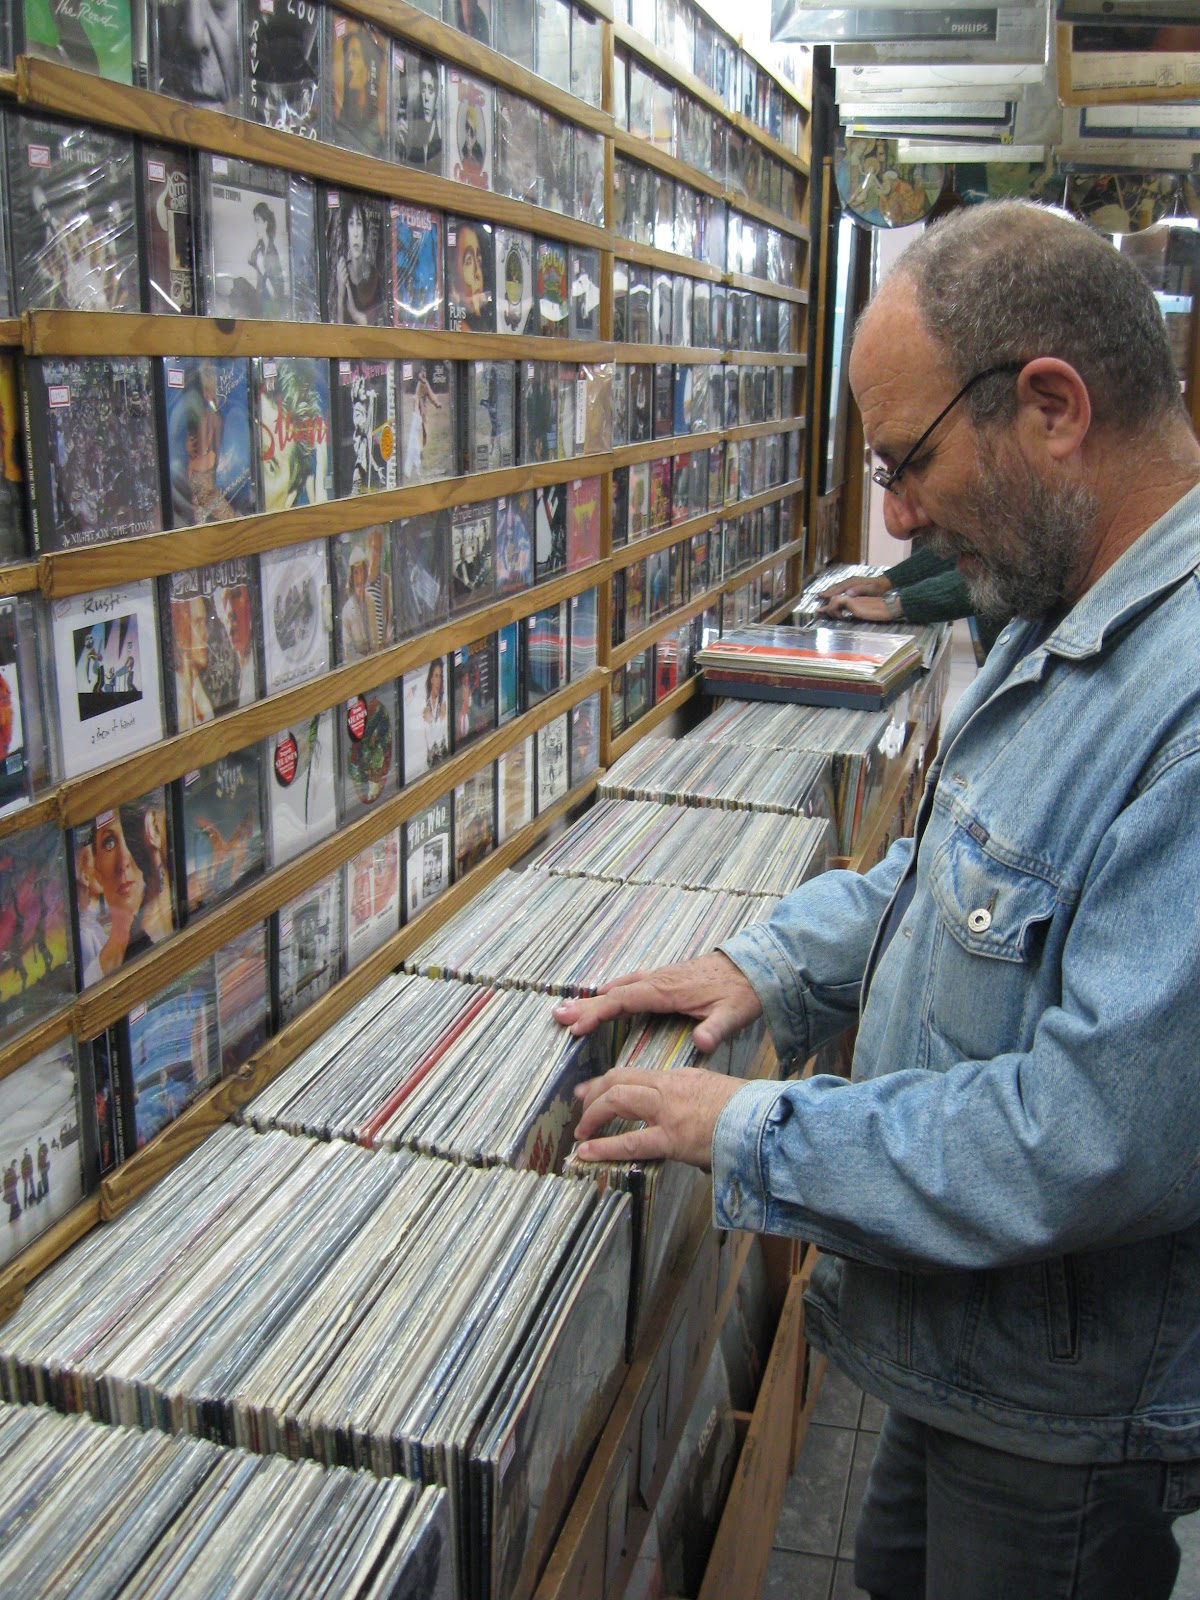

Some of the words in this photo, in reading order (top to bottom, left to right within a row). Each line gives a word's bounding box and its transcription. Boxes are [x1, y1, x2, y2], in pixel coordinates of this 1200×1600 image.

[951, 23, 988, 33] PHILIPS
[408, 821, 425, 850] The
[427, 804, 446, 837] Who
